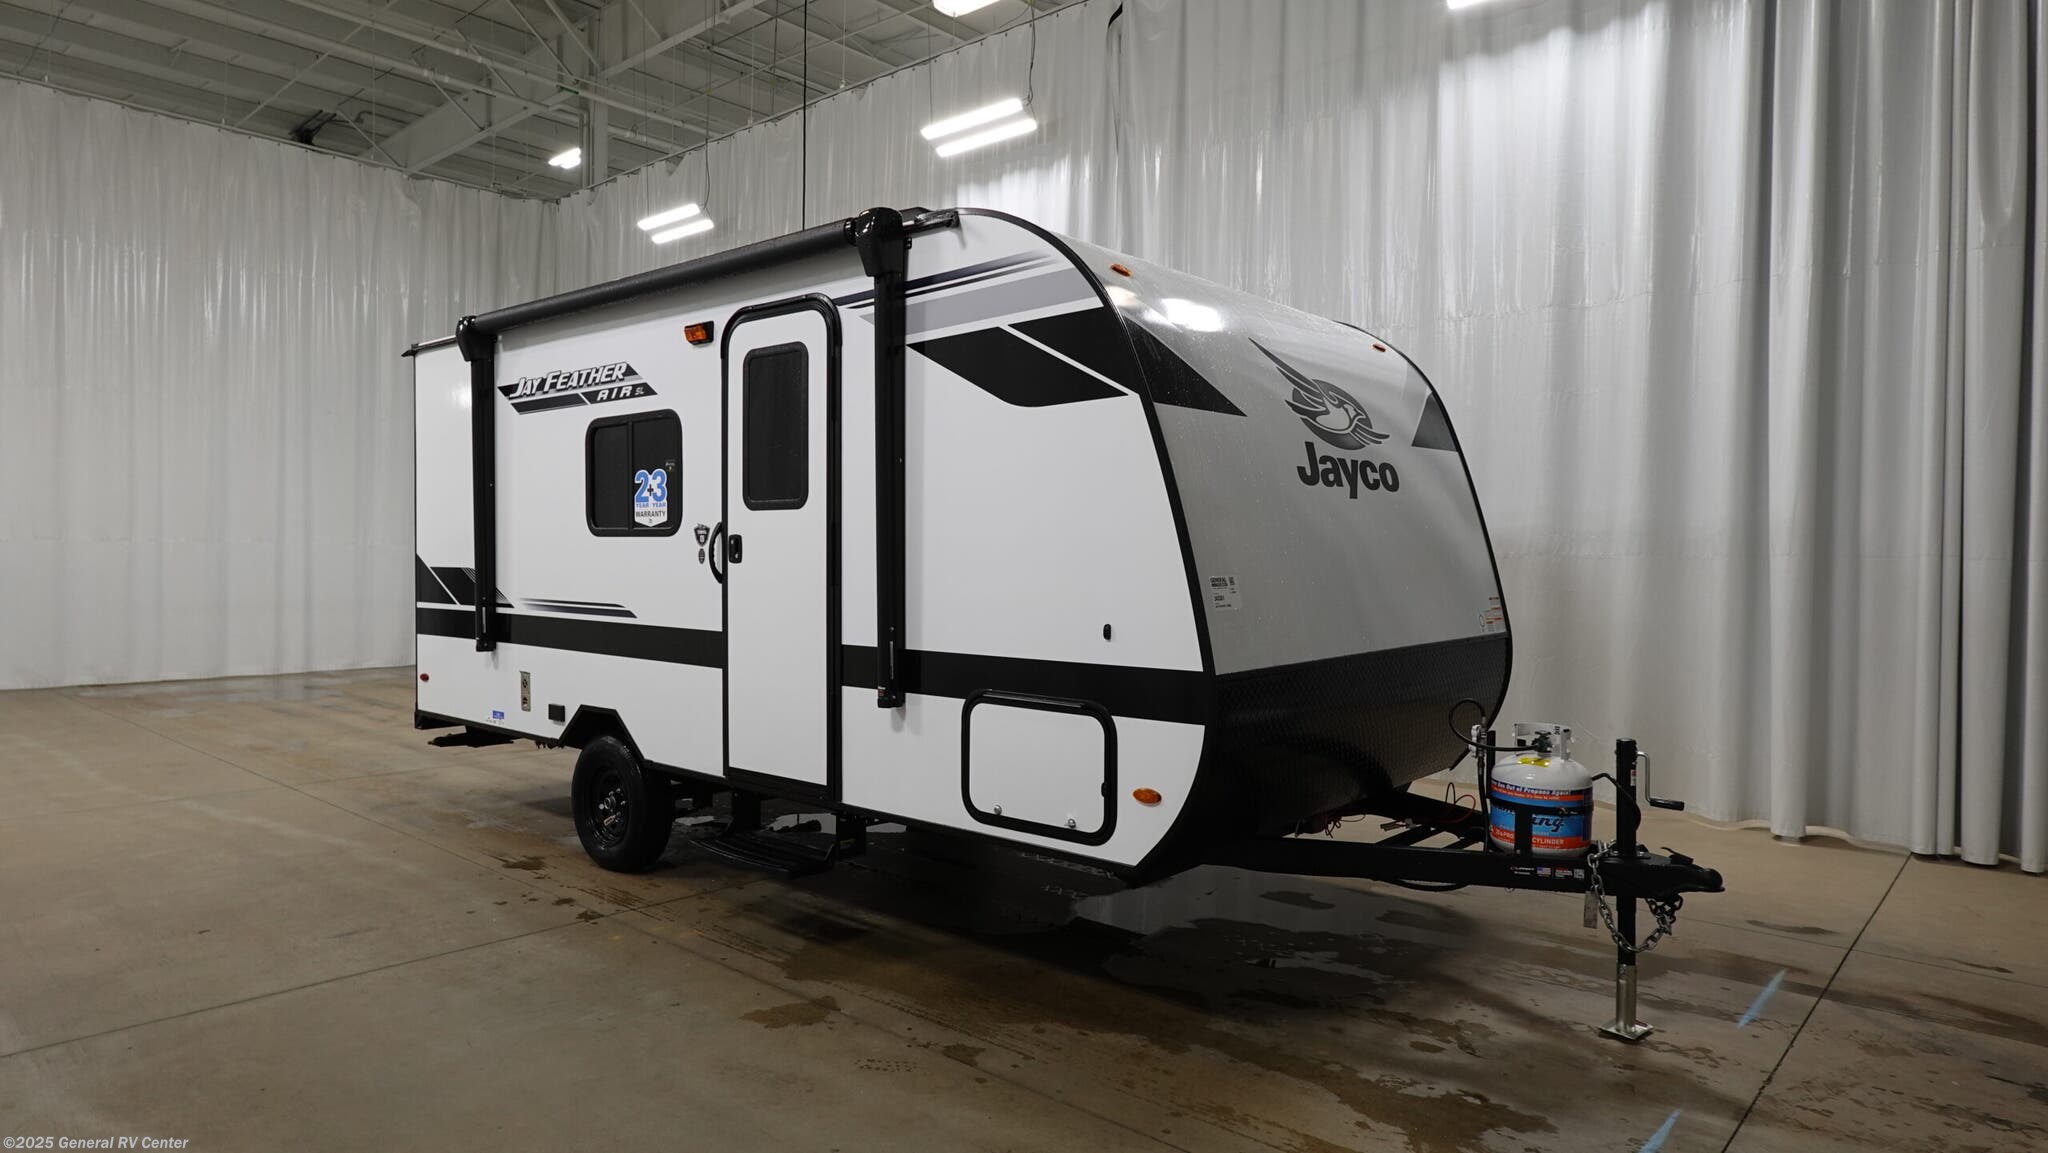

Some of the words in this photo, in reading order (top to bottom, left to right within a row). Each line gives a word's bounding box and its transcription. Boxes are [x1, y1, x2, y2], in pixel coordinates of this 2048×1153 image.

[509, 376, 545, 399] JAY
[542, 361, 629, 394] FEATHER
[597, 385, 634, 402] AIR
[1296, 441, 1400, 499] Jayco
[636, 510, 667, 518] WARRANTY
[1532, 837, 1564, 845] CYLINDER
